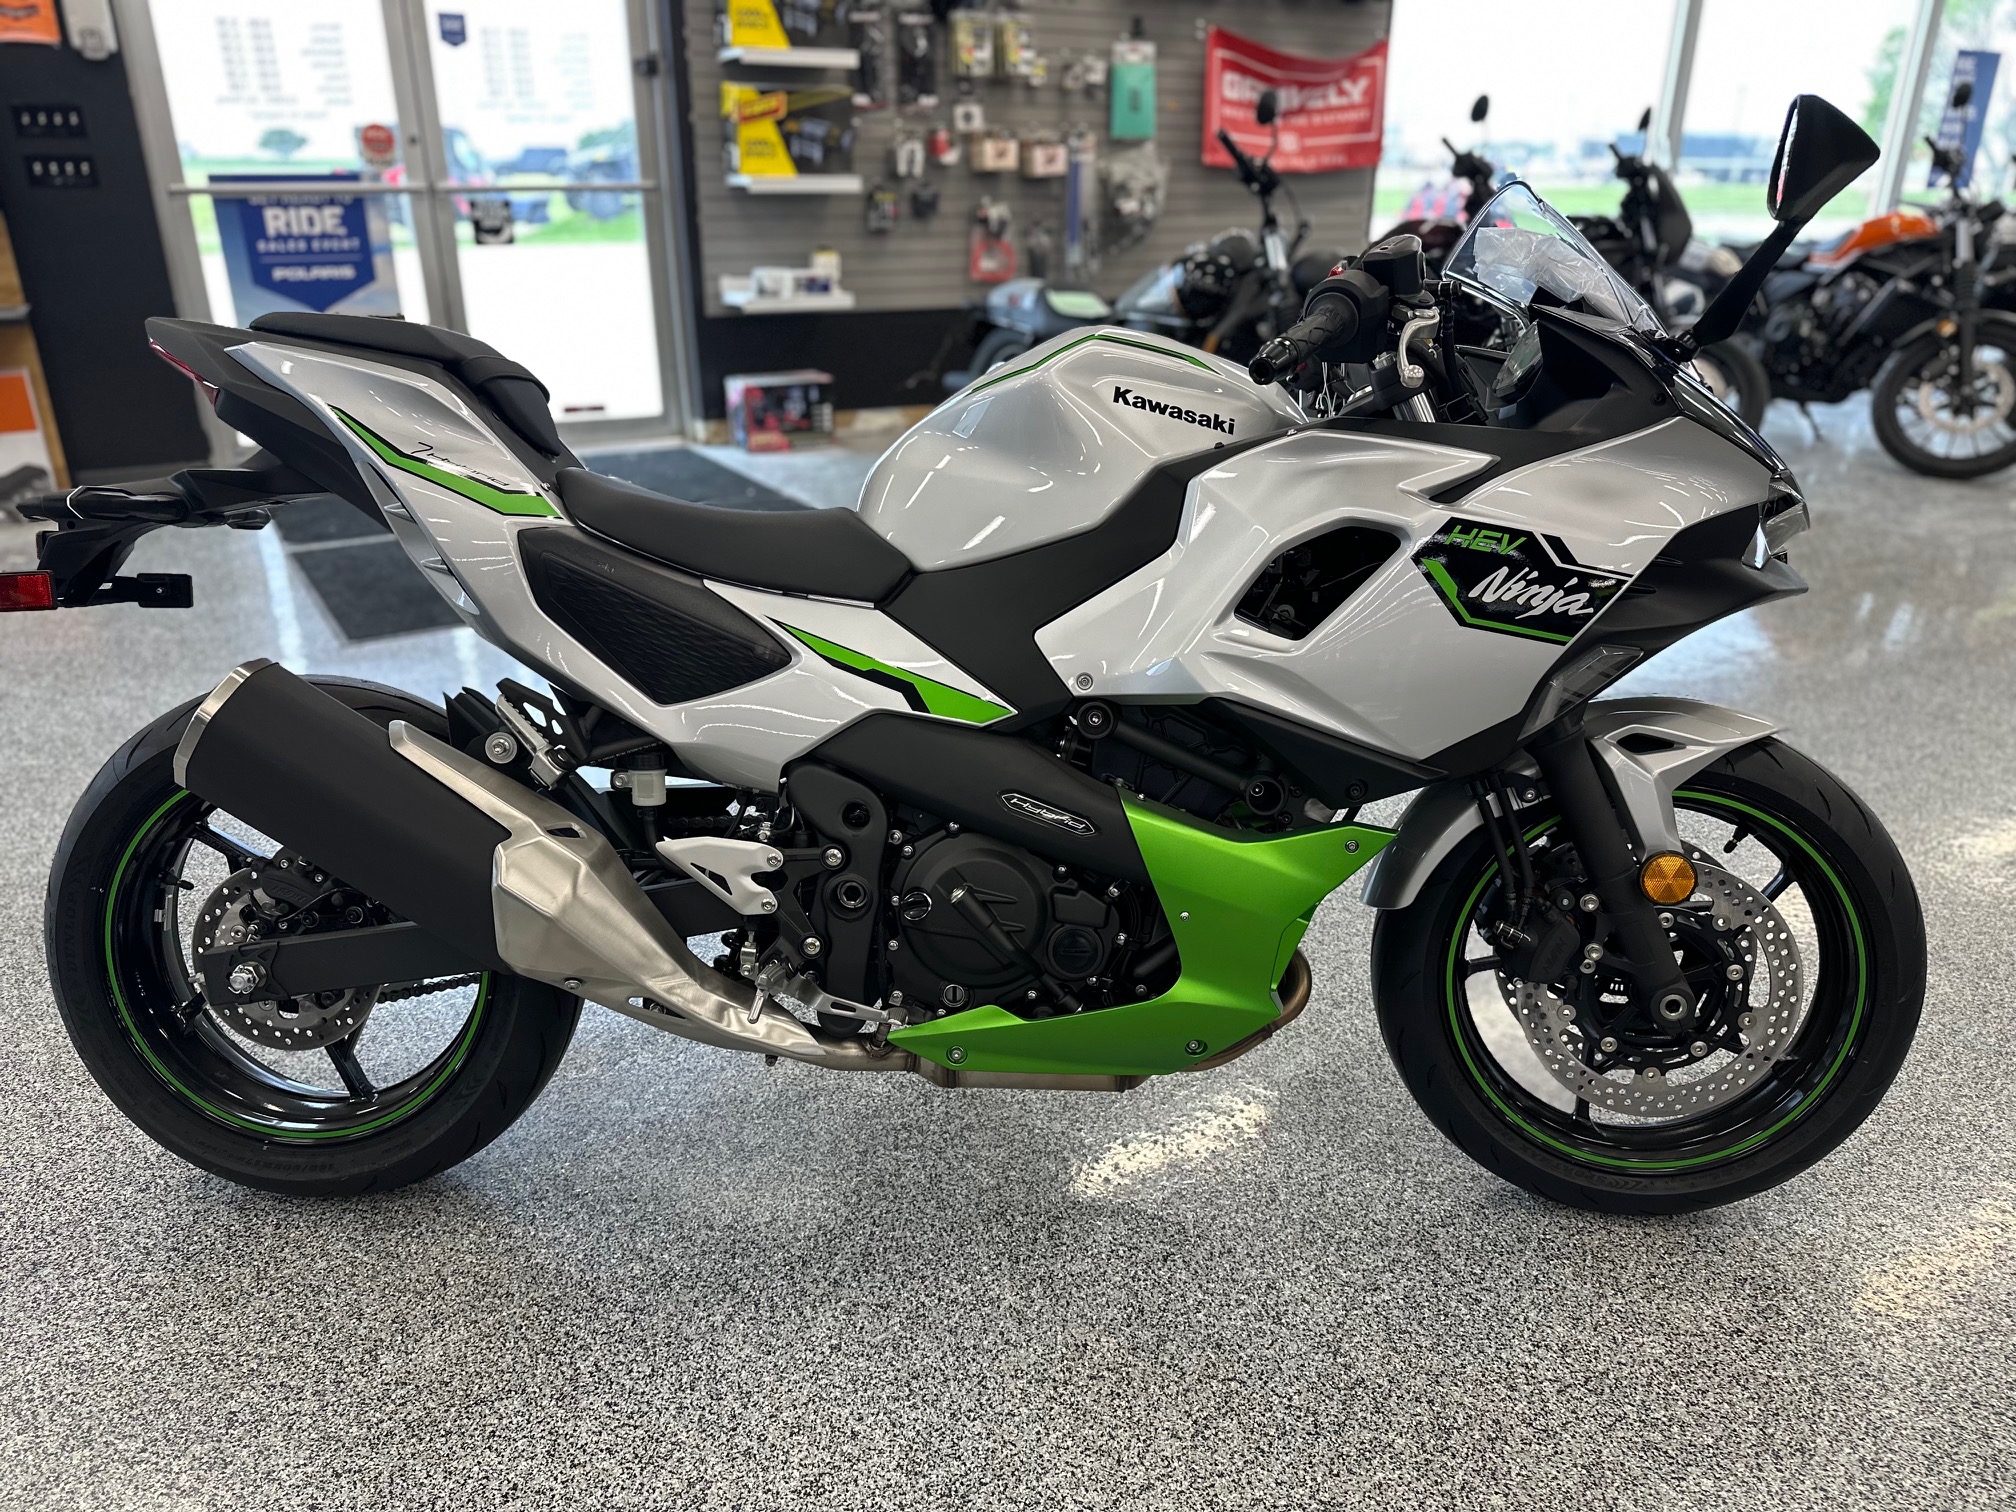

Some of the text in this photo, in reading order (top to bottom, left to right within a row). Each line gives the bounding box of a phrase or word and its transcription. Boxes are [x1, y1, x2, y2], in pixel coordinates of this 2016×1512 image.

[1222, 72, 1370, 113] GRVELY
[262, 206, 348, 238] RIDE
[1113, 386, 1235, 435] Kawasaki
[1445, 525, 1527, 555] HEV
[1468, 566, 1594, 619] Ninja
